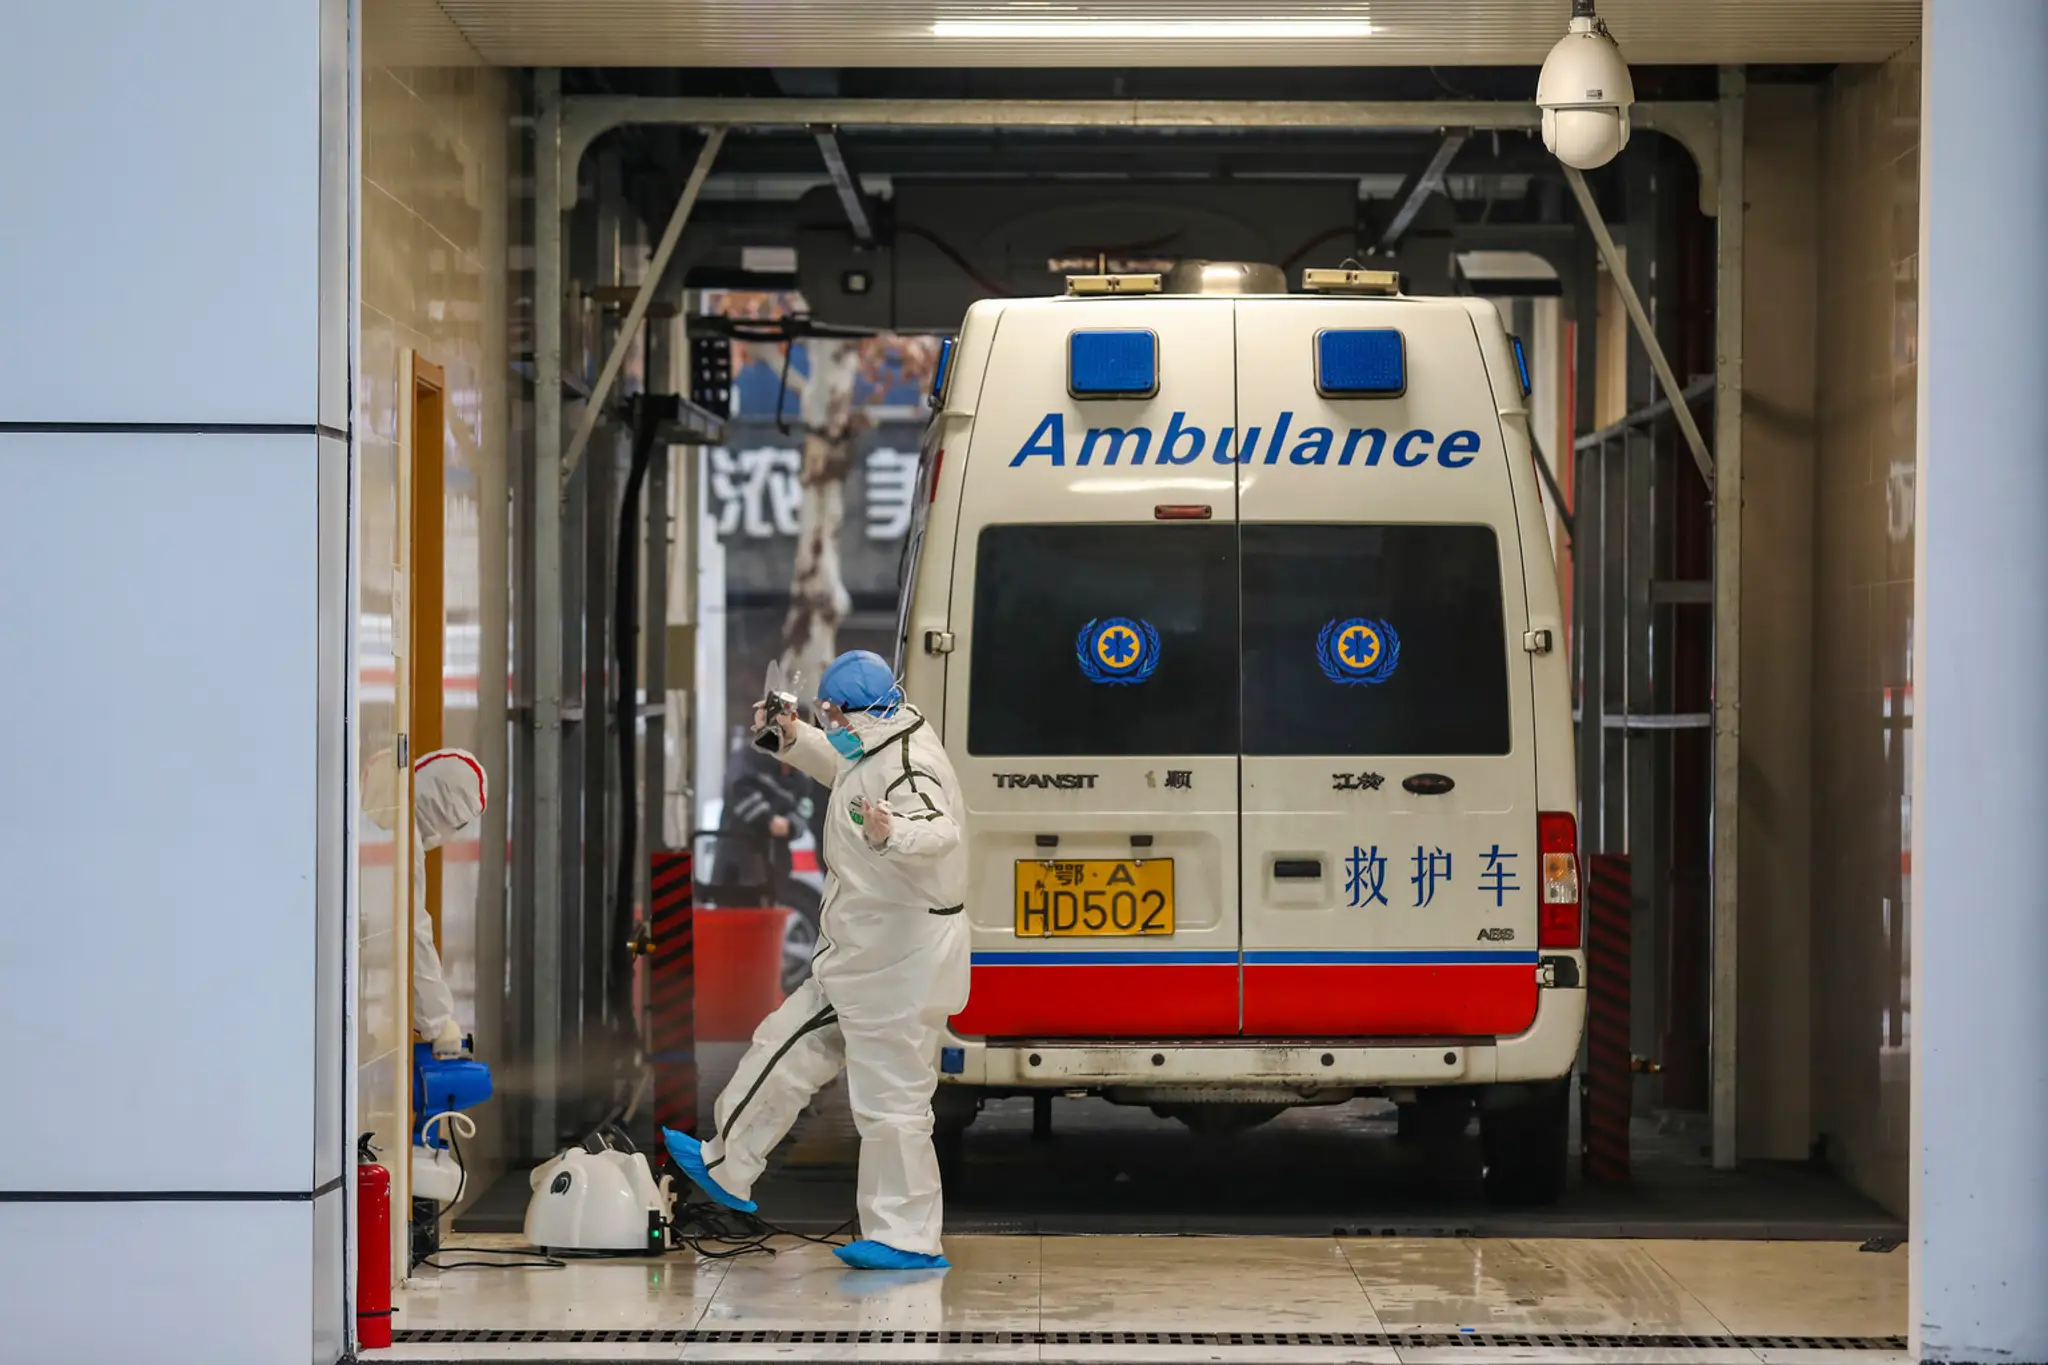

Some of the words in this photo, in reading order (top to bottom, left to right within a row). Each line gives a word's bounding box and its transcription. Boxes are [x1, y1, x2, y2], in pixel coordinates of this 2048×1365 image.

[1009, 412, 1481, 468] Ambulance
[992, 773, 1099, 789] TRANSIT
[1344, 844, 1521, 908] 救护车
[1024, 889, 1166, 932] HD502
[1476, 927, 1515, 942] ABS
